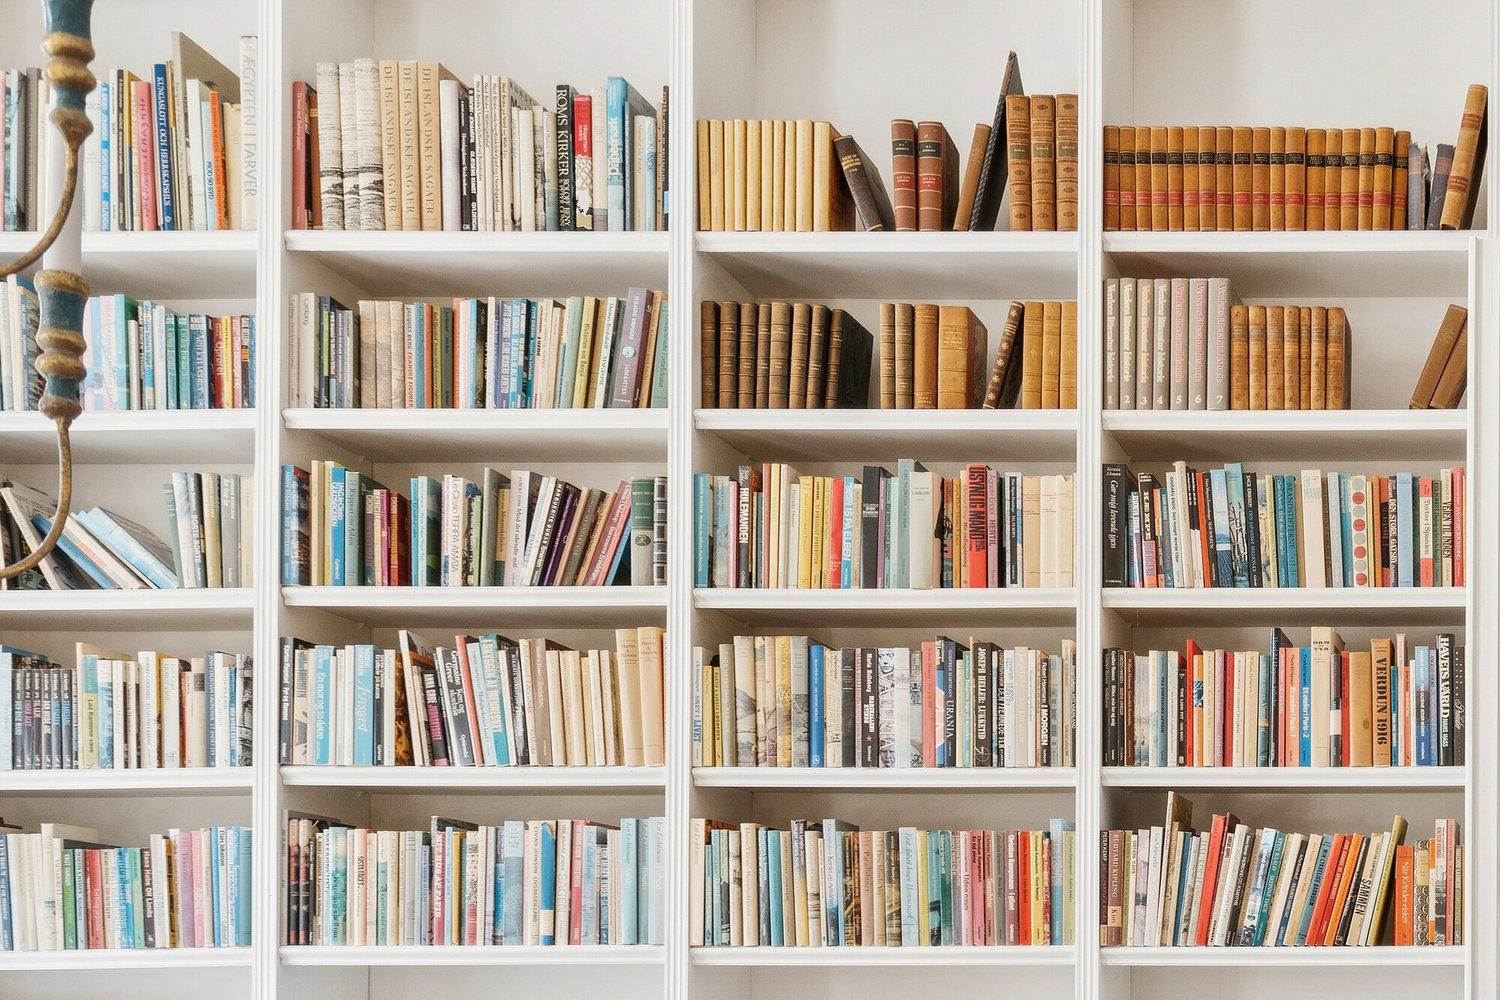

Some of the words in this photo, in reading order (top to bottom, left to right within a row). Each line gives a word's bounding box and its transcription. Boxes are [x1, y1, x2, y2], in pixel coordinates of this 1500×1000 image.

[384, 66, 393, 82] DE
[403, 67, 412, 84] DE
[422, 68, 432, 84] DE
[156, 77, 167, 126] KUNGASLOTT
[242, 55, 255, 127] ÆGYPTEN
[384, 87, 395, 159] ISLANDSKE
[556, 90, 569, 126] ROMS
[159, 129, 168, 146] OCH
[402, 88, 415, 160] ISLANDSKE
[423, 88, 434, 161] ISLANDSKE
[557, 130, 569, 175] KIRKER
[160, 148, 172, 206] HERRSKAPSHUS
[244, 142, 257, 197] FARVER
[387, 164, 398, 213] SAGAER
[405, 164, 416, 213] SAGAER
[424, 165, 435, 214] SAGAER
[1107, 284, 1115, 315] Verdens
[1217, 284, 1226, 315] Verdens
[1107, 317, 1115, 351] litteratur
[1217, 317, 1225, 351] litteratur
[1107, 352, 1115, 382] historie
[1217, 352, 1225, 382] historie
[1105, 395, 1114, 404] 1
[1216, 395, 1223, 404] 7
[969, 467, 985, 508] USYNLIG
[1108, 496, 1118, 508] mig
[1110, 480, 1119, 495] Gør
[739, 488, 749, 543] HULEMANDEN
[844, 508, 853, 517] IS
[844, 519, 853, 532] PÅ
[969, 511, 985, 540] MAND
[1110, 510, 1118, 532] levende
[843, 533, 852, 560] ELBEN
[1110, 534, 1118, 548] igen
[445, 662, 454, 683] Greer
[451, 651, 461, 685] Germaine
[978, 647, 986, 674] JOSEPH
[1441, 637, 1450, 678] HAVETS
[978, 677, 986, 703] HELLER:
[1376, 658, 1388, 715] VERDUN
[1441, 681, 1452, 718] VÄRLD
[978, 706, 986, 739] LUKKETID
[1377, 718, 1389, 745] 1916
[1111, 868, 1119, 897] KIPLING
[1355, 879, 1371, 915] SAMMEN
